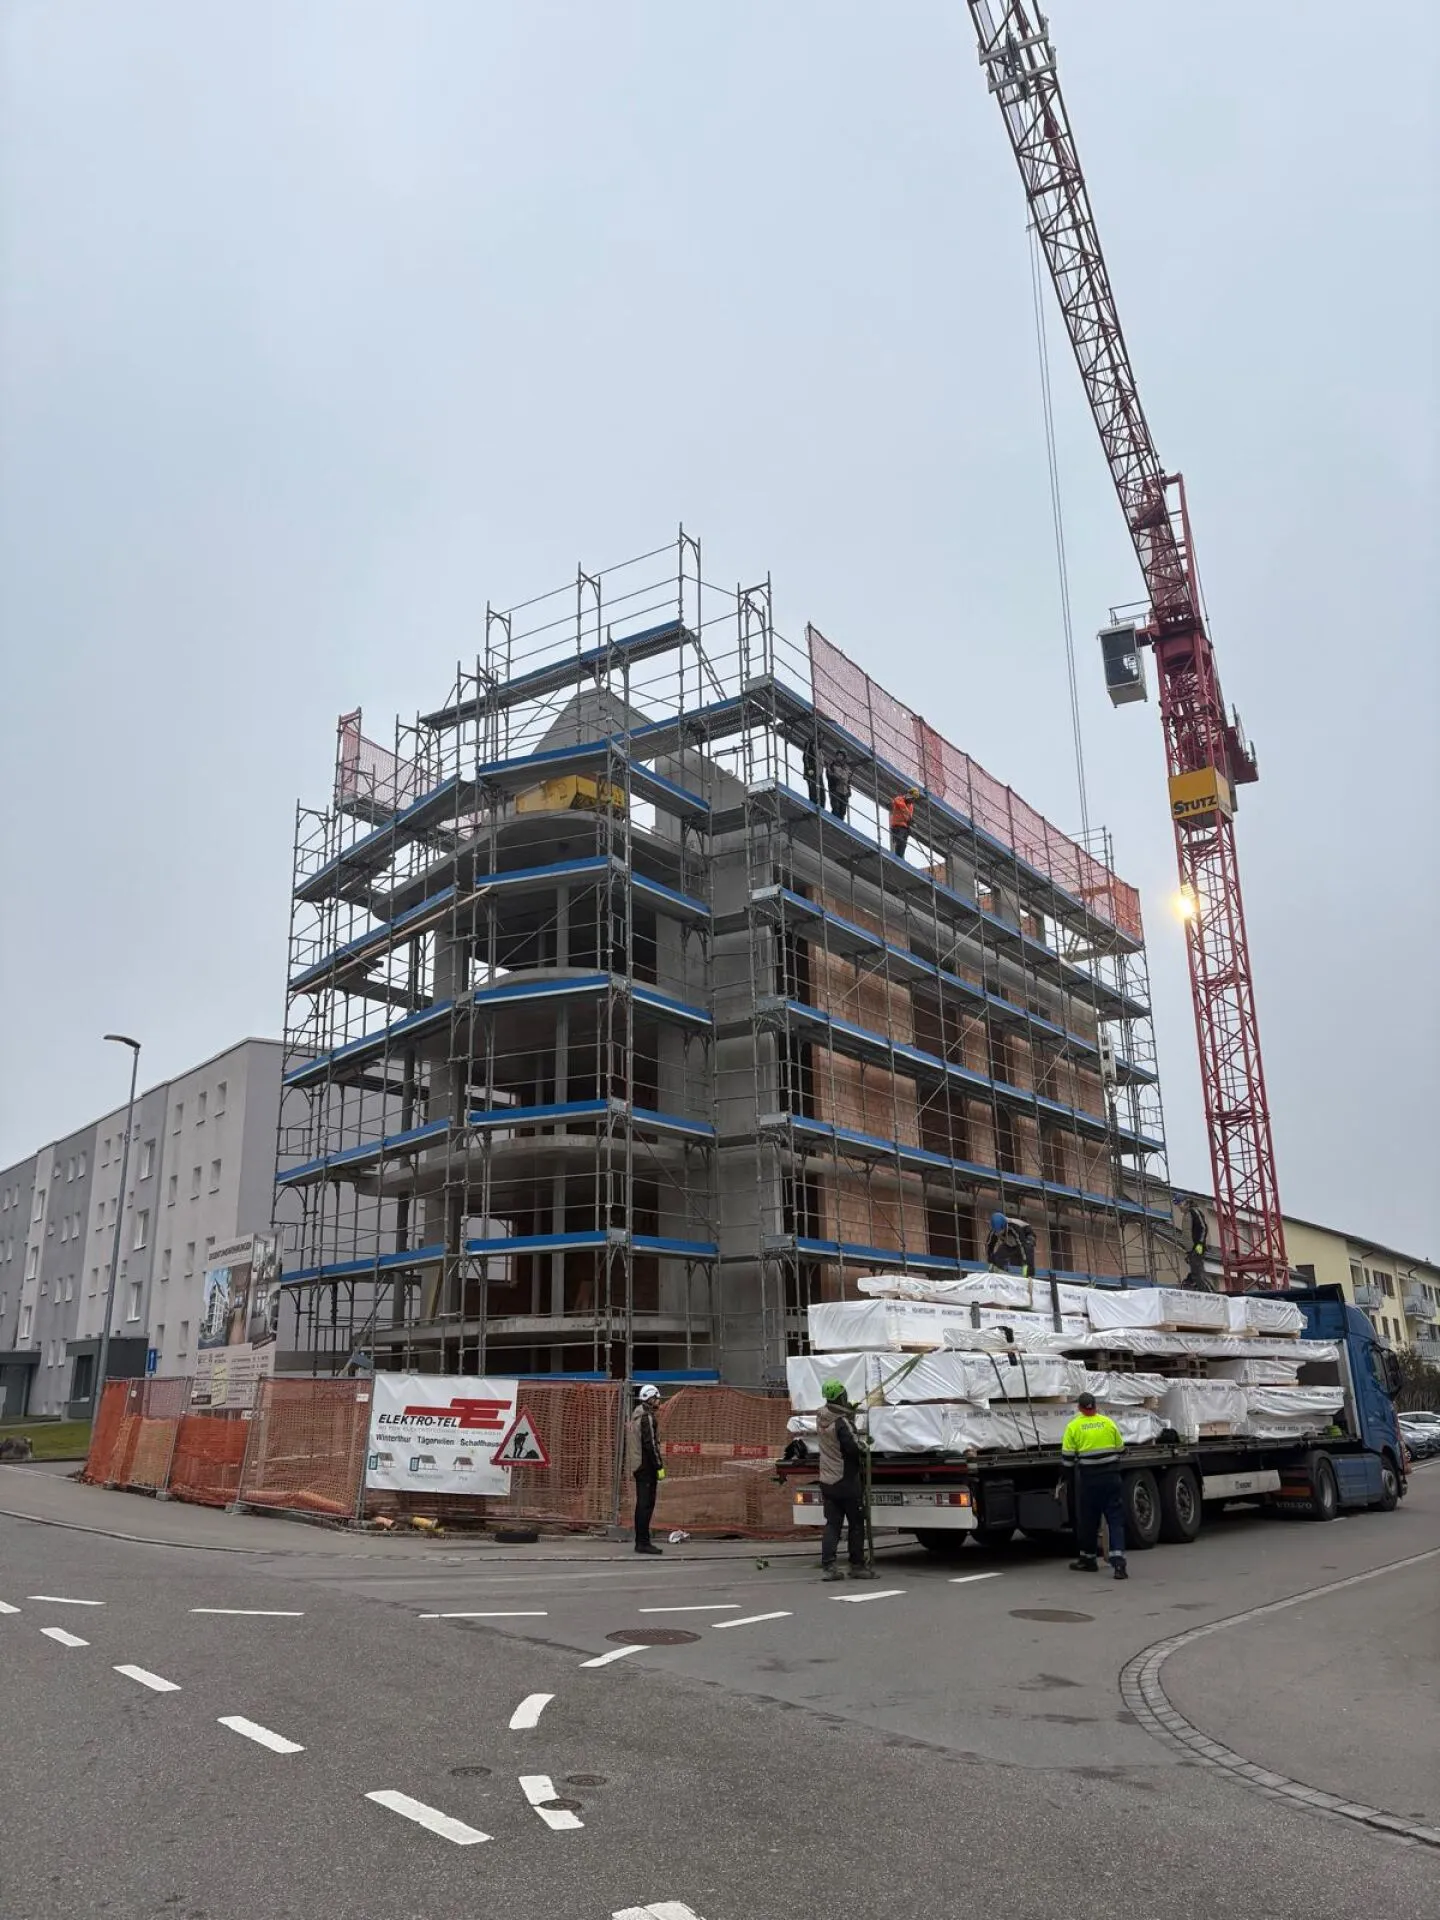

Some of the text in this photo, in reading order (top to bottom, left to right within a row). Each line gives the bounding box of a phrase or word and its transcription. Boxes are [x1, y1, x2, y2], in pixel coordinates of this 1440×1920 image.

[1174, 795, 1217, 815] STUTZ
[378, 1414, 457, 1428] ELEKTRO-TEL
[376, 1433, 411, 1443] Winterthur
